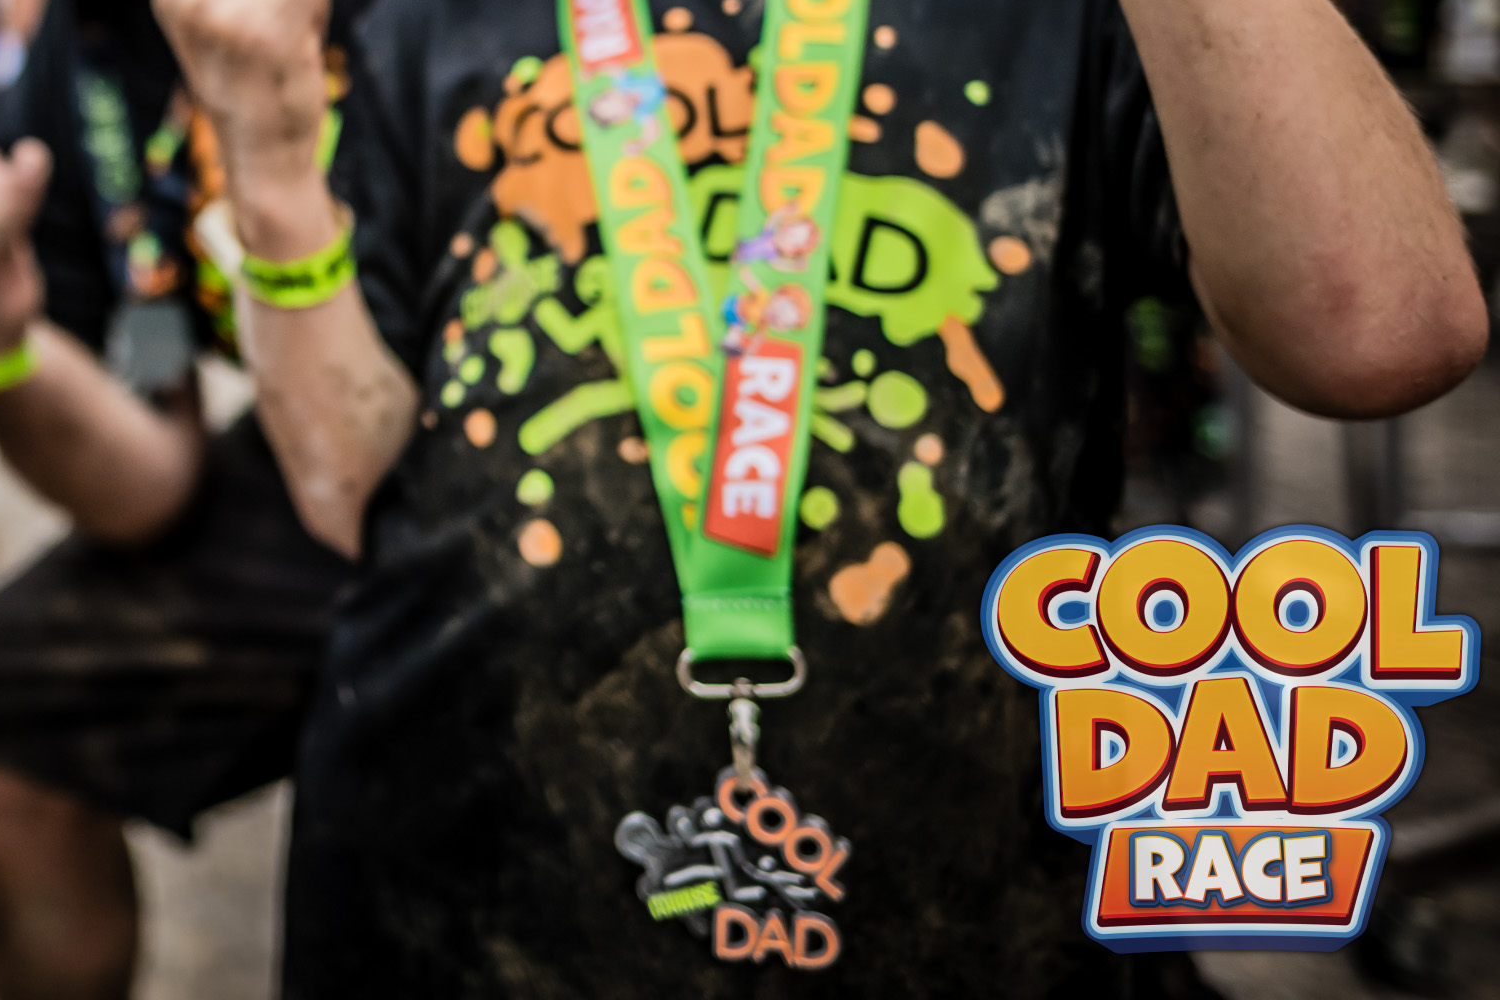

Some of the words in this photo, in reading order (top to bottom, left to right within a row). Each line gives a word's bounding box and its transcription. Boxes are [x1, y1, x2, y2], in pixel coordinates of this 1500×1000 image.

[719, 354, 797, 521] RACE
[716, 772, 847, 903] COOL
[715, 906, 841, 971] DAD
